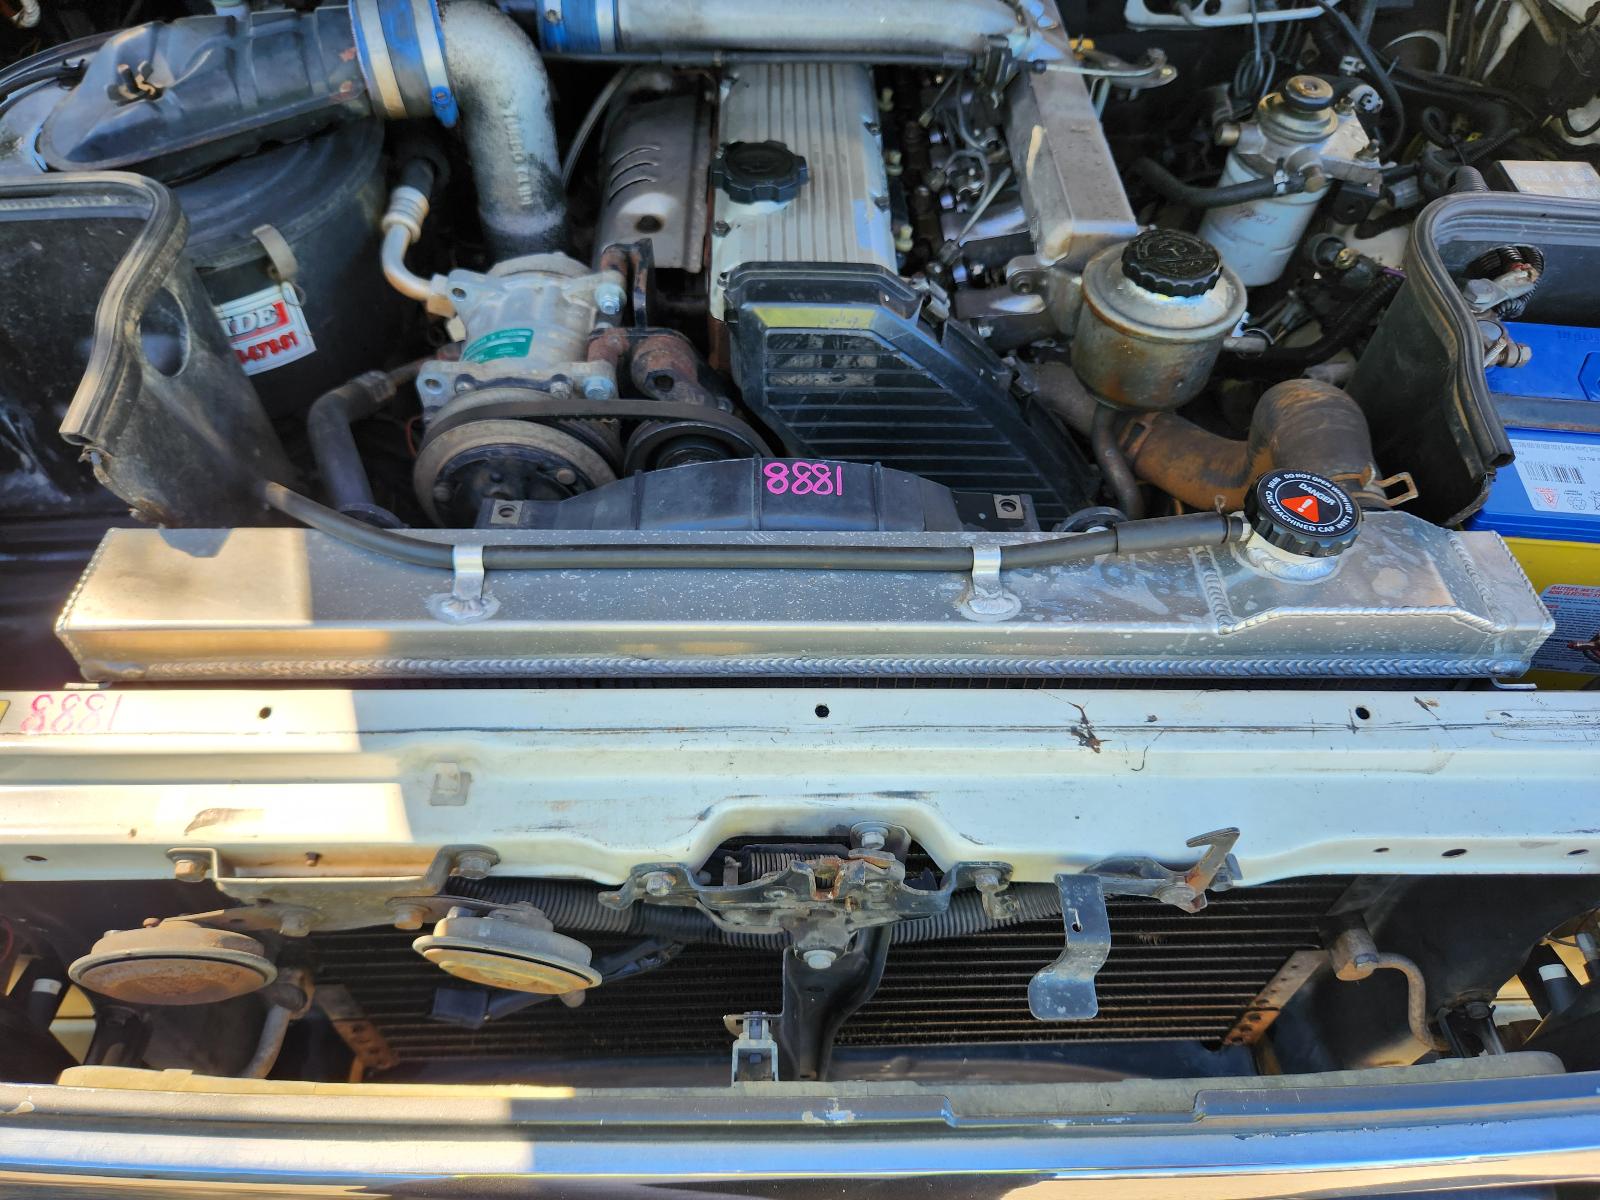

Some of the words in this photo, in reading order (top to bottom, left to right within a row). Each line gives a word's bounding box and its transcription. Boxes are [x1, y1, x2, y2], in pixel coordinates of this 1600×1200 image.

[763, 461, 843, 496] 8881
[1298, 482, 1337, 506] DANGER
[1312, 476, 1332, 488] OPEN
[1331, 486, 1349, 503] WHEN
[1344, 502, 1353, 514] HOT
[1265, 490, 1275, 505] CNC
[1270, 504, 1316, 532] MACHINED
[1317, 525, 1335, 533] CAP
